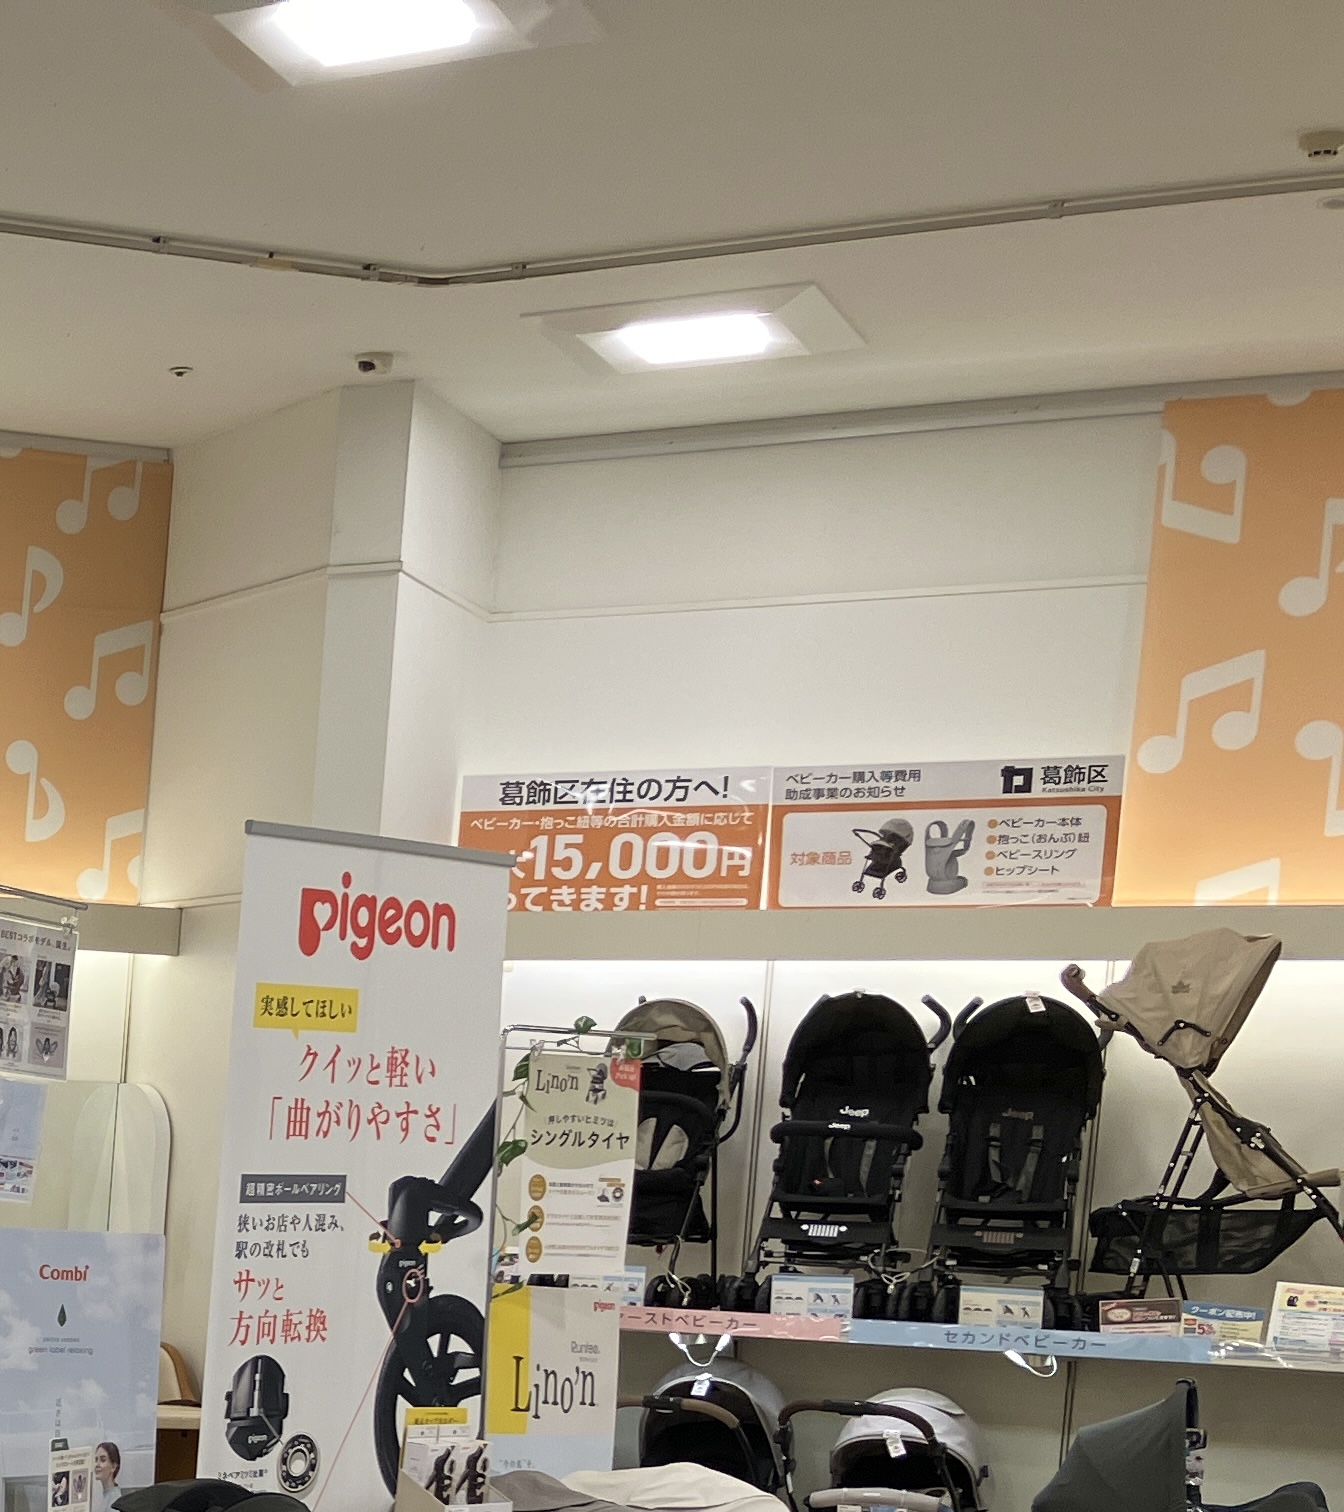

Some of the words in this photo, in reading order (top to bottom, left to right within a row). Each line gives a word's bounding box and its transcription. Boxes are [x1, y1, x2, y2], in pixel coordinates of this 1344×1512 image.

[784, 769, 923, 784] ベビーカー購入等費用
[1039, 763, 1110, 787] 葛飾区
[498, 775, 730, 807] 葛飾区在住の方へ!
[784, 785, 906, 801] 助成事業のお知らせ
[470, 811, 754, 831] ベビーカー・抱っこ紐等の合計購入金額に応じて
[998, 816, 1083, 829] ベビーカー本体
[789, 851, 853, 867] 対象商品
[995, 848, 1078, 861] ベビースリング
[994, 864, 1060, 877] ヒップシート
[297, 871, 456, 960] pigeon
[259, 993, 354, 1020] 実感してほしい
[297, 1043, 438, 1089] クイッと軽い
[267, 1096, 458, 1147] 「曲がりやすさ」
[547, 1113, 615, 1128] 押しやすいヒミツは
[839, 1105, 870, 1118] Jeep
[827, 1121, 852, 1131] Jeep
[528, 1128, 631, 1151] シングルタイヤ
[245, 1181, 343, 1198] 超精密ボールベアリング
[236, 1213, 345, 1234] 狭いお店や人混み、
[234, 1238, 311, 1260] 駅の改札でも
[38, 1263, 91, 1283] Combi
[232, 1268, 286, 1302] サッと
[228, 1306, 329, 1347] 方向転換
[942, 1326, 1108, 1352] セカンドベビーカー
[509, 1355, 597, 1421] Lino'n
